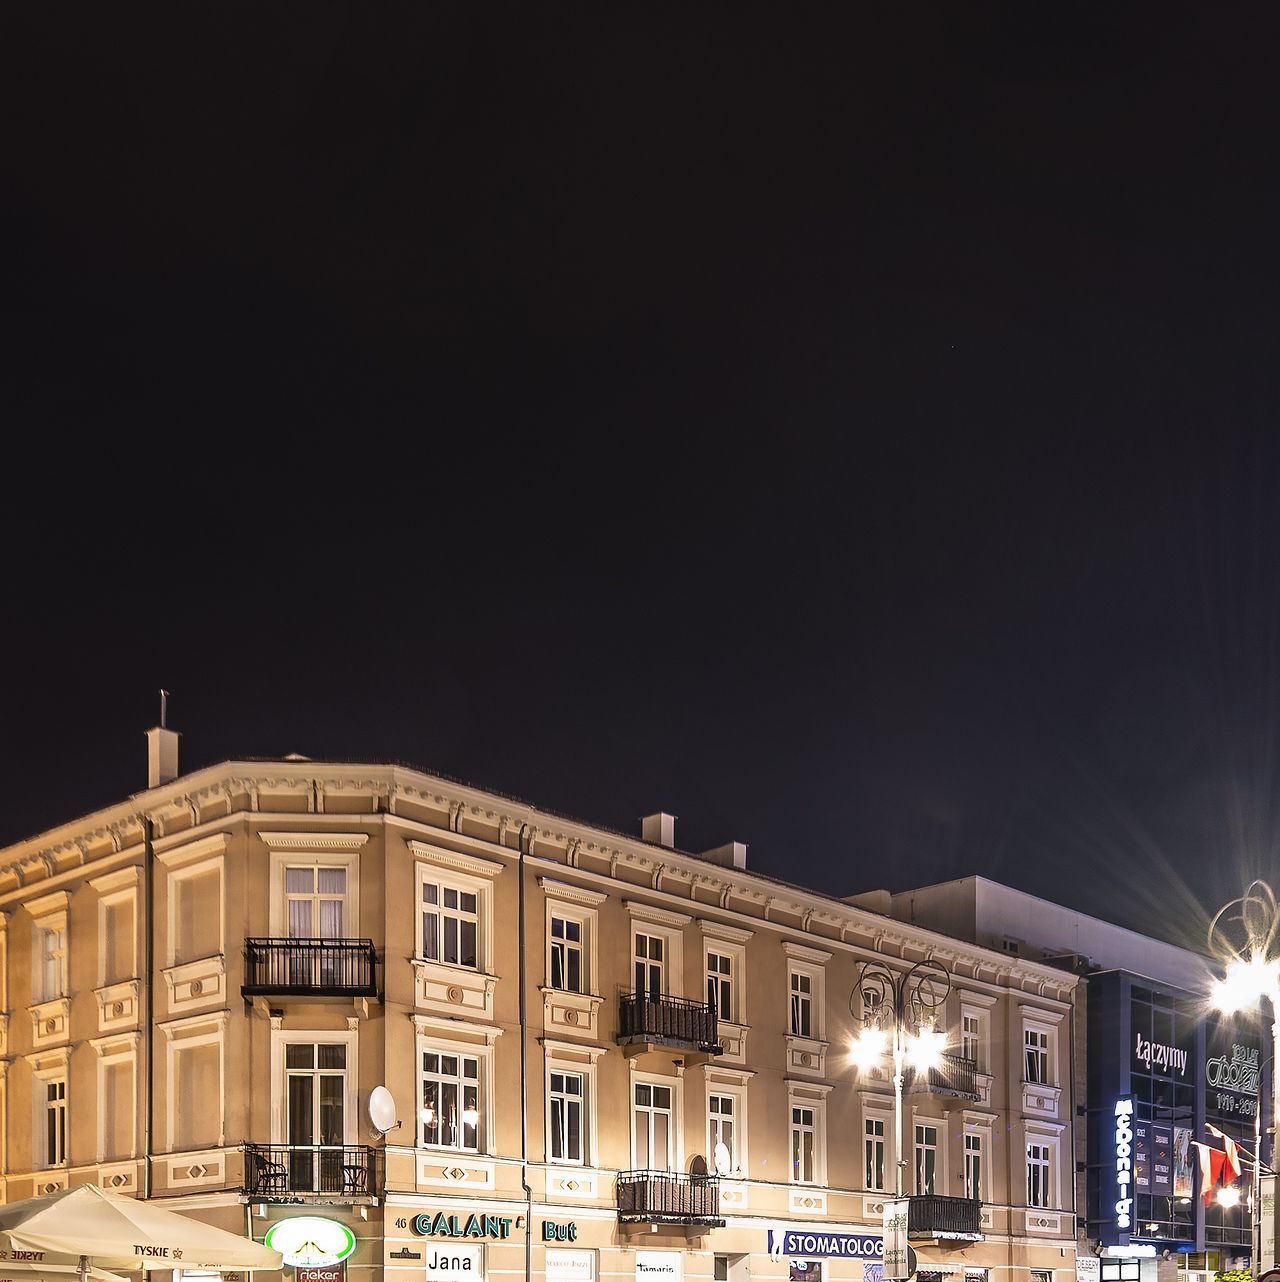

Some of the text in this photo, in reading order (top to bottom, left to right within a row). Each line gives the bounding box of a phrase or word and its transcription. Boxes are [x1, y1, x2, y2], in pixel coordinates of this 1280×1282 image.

[1135, 1032, 1187, 1076] Łączymy
[395, 1217, 407, 1229] 46
[412, 1212, 512, 1239] GALANT
[542, 1220, 577, 1242] But
[133, 1244, 169, 1258] TYSKIE
[428, 1251, 471, 1271] Jana
[636, 1263, 674, 1273] Tamaris
[300, 1268, 340, 1280] rieker
